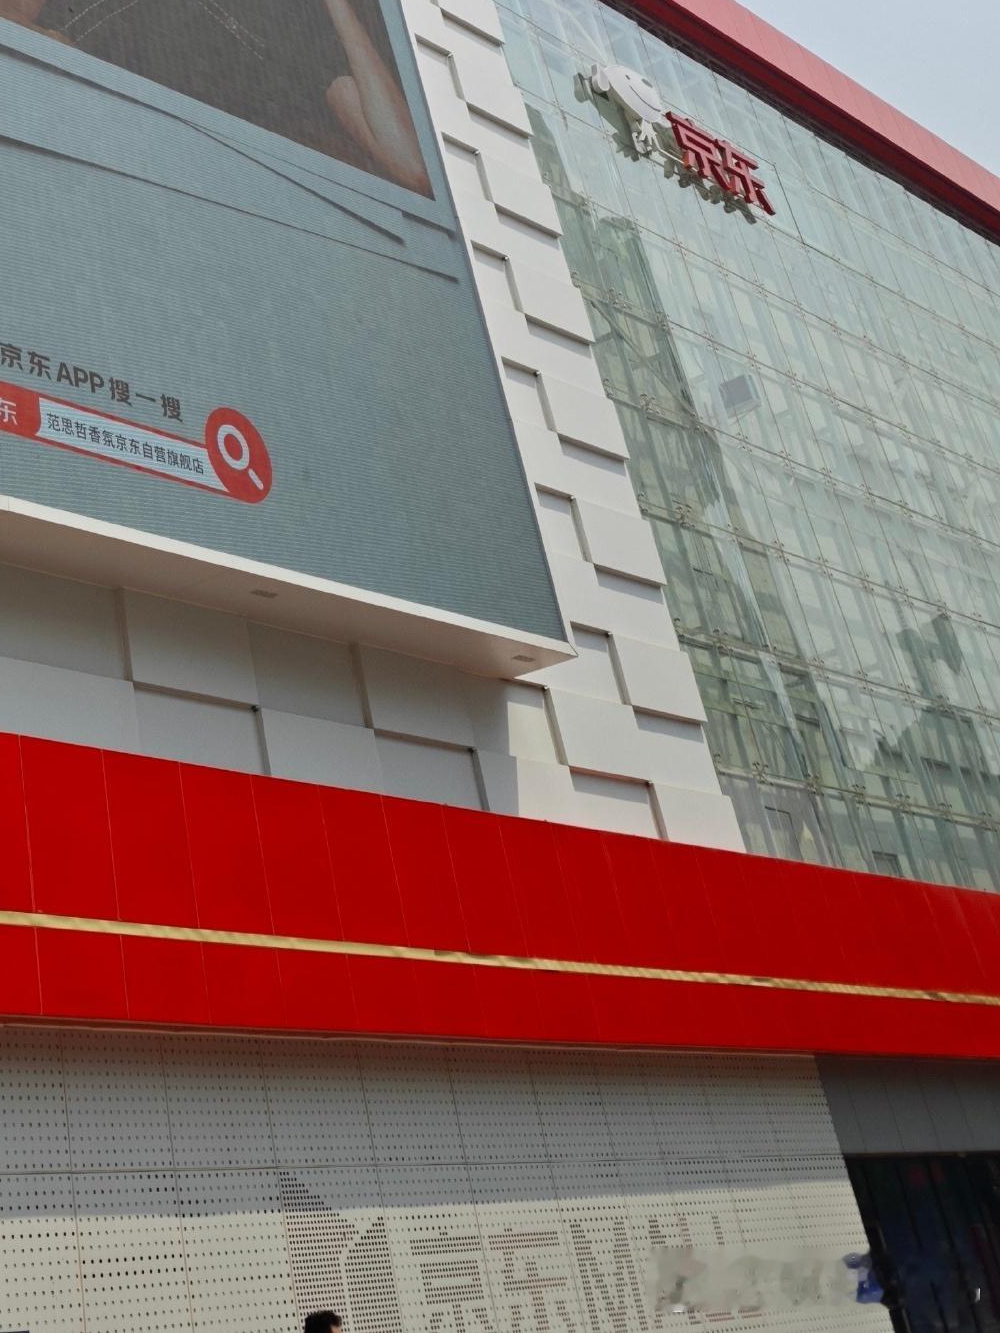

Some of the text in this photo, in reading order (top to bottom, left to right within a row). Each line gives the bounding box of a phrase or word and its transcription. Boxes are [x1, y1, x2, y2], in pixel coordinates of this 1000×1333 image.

[664, 111, 776, 216] 京东
[46, 412, 204, 475] 范思哲香氛京东自营旗舰店
